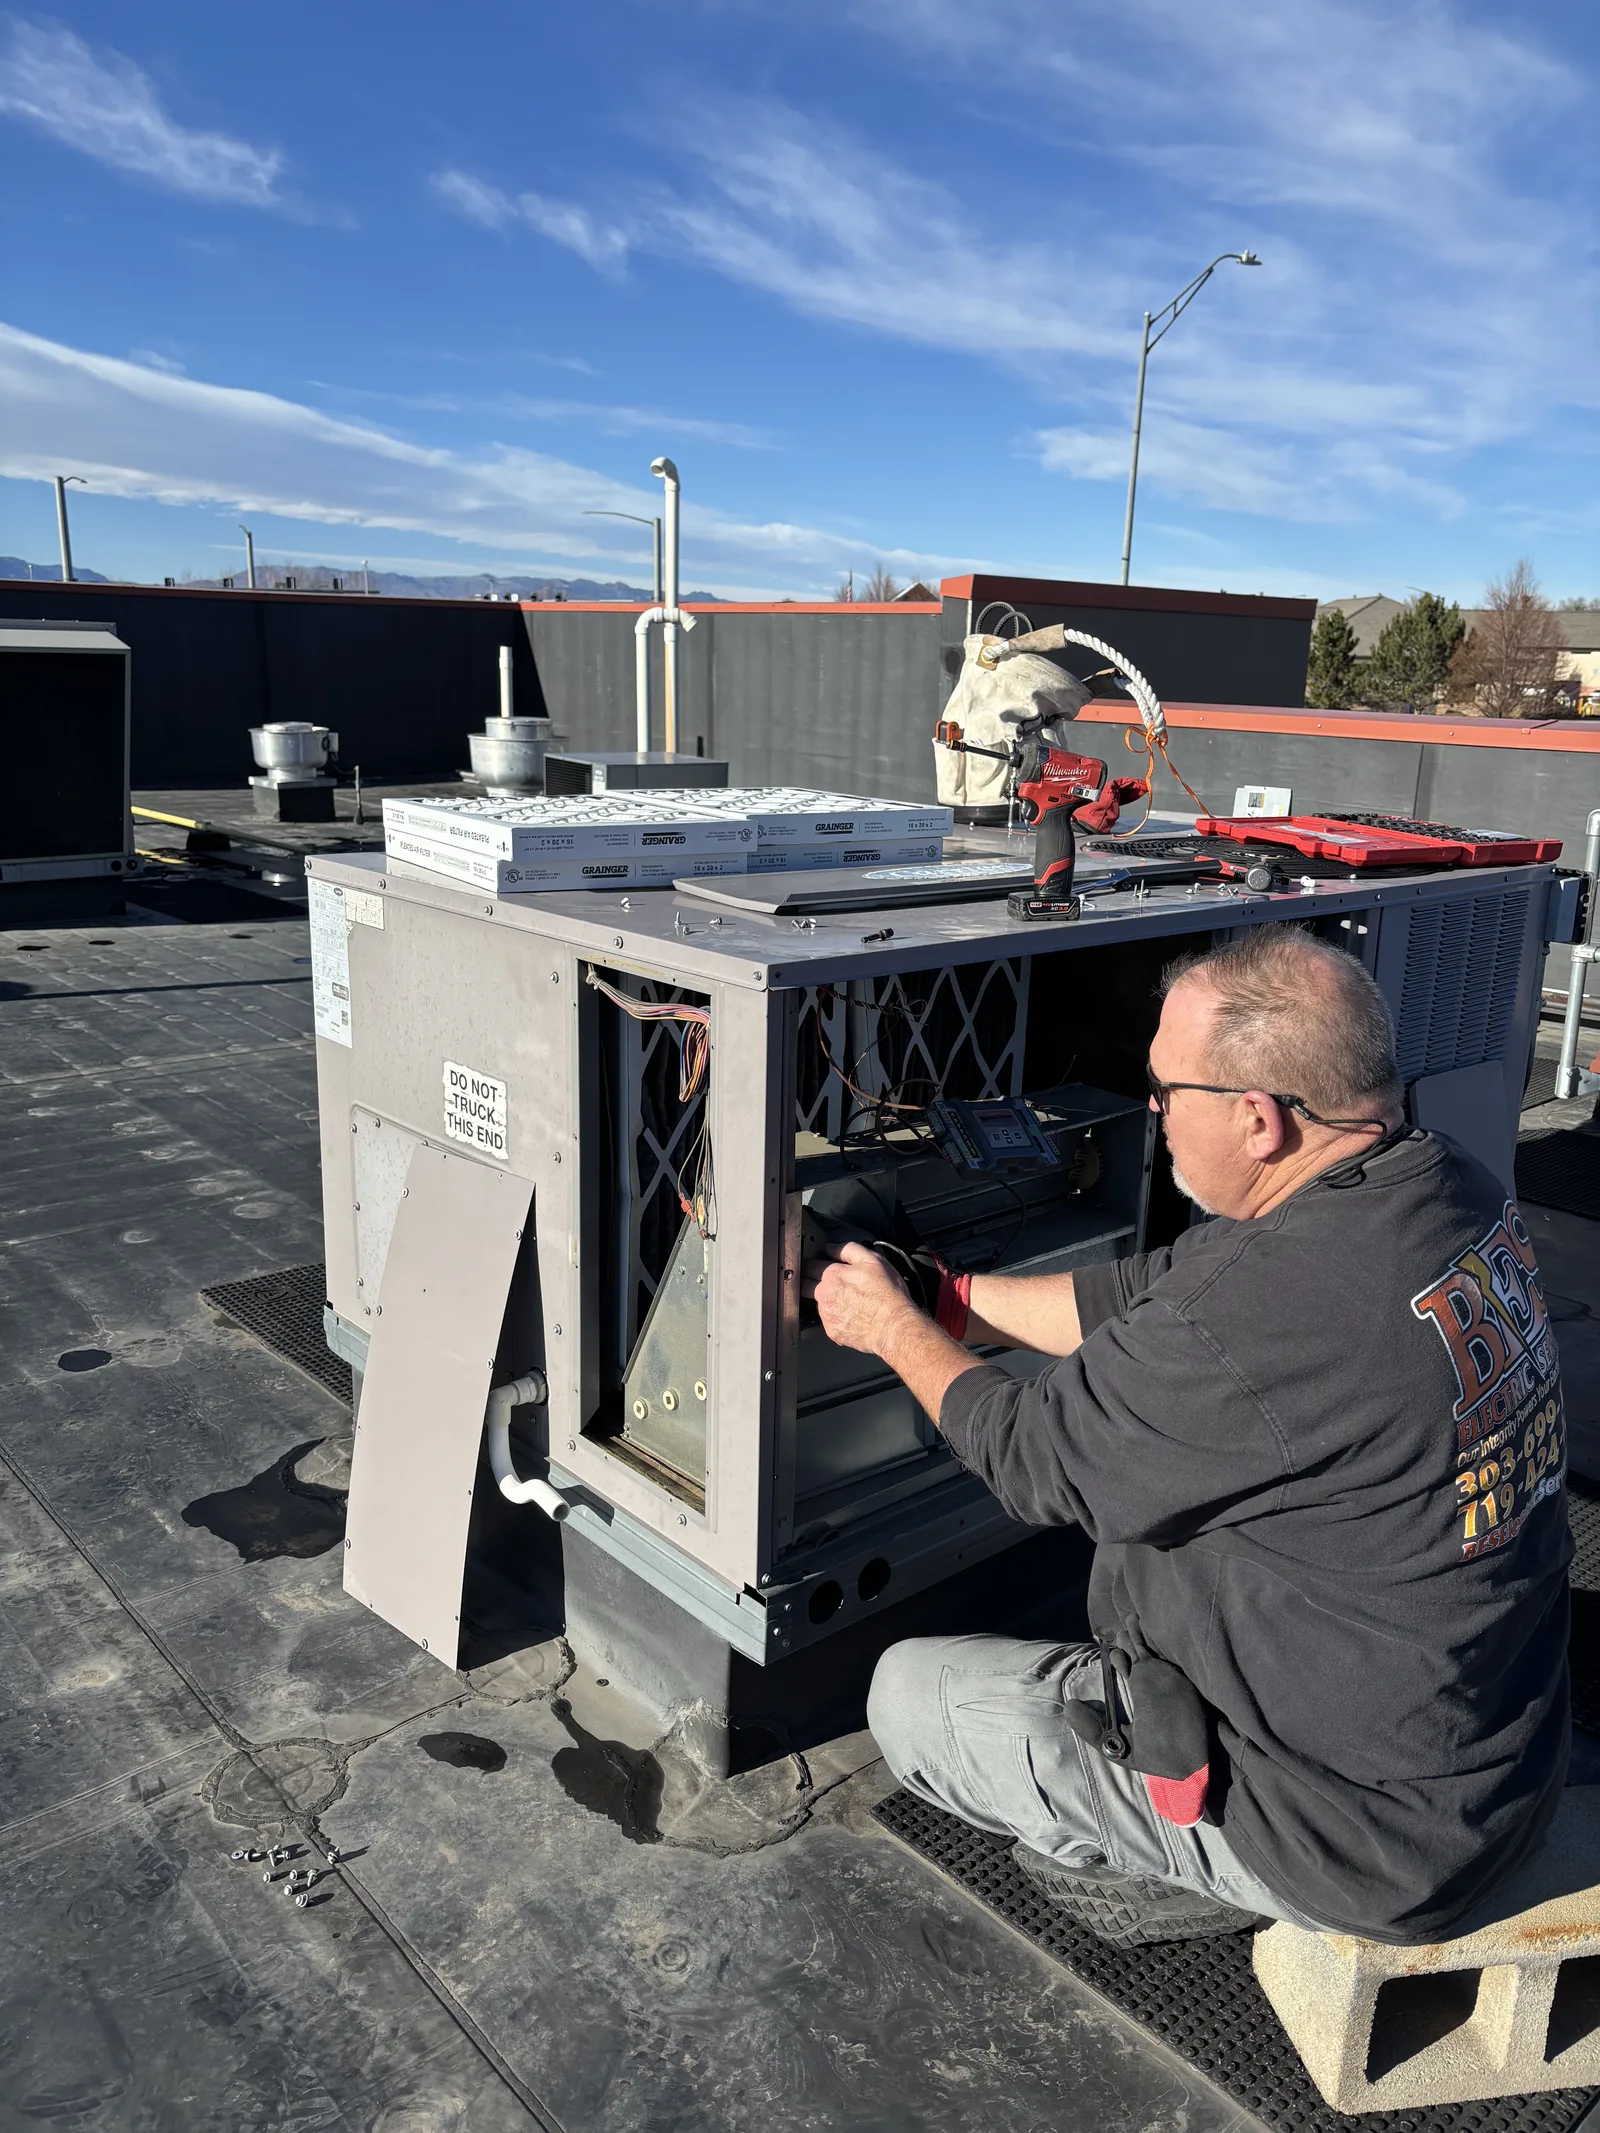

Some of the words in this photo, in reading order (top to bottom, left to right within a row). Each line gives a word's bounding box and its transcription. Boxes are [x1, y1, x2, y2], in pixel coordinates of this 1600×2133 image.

[1043, 762, 1088, 777] Milwaukee
[815, 822, 854, 832] GRAINGER
[642, 836, 686, 846] GRAINGER
[843, 853, 881, 862] GRAINGER
[582, 865, 629, 874] GRAINGER
[450, 1070, 468, 1091] DO
[471, 1081, 498, 1102] NOT
[452, 1093, 496, 1125] TRUCK
[447, 1112, 474, 1138] THIS
[477, 1126, 503, 1150] END
[1457, 1358, 1536, 1451] ELECTRIC
[1457, 1446, 1480, 1468] Our
[1480, 1418, 1517, 1457] Integrity
[1516, 1394, 1537, 1428] Powers
